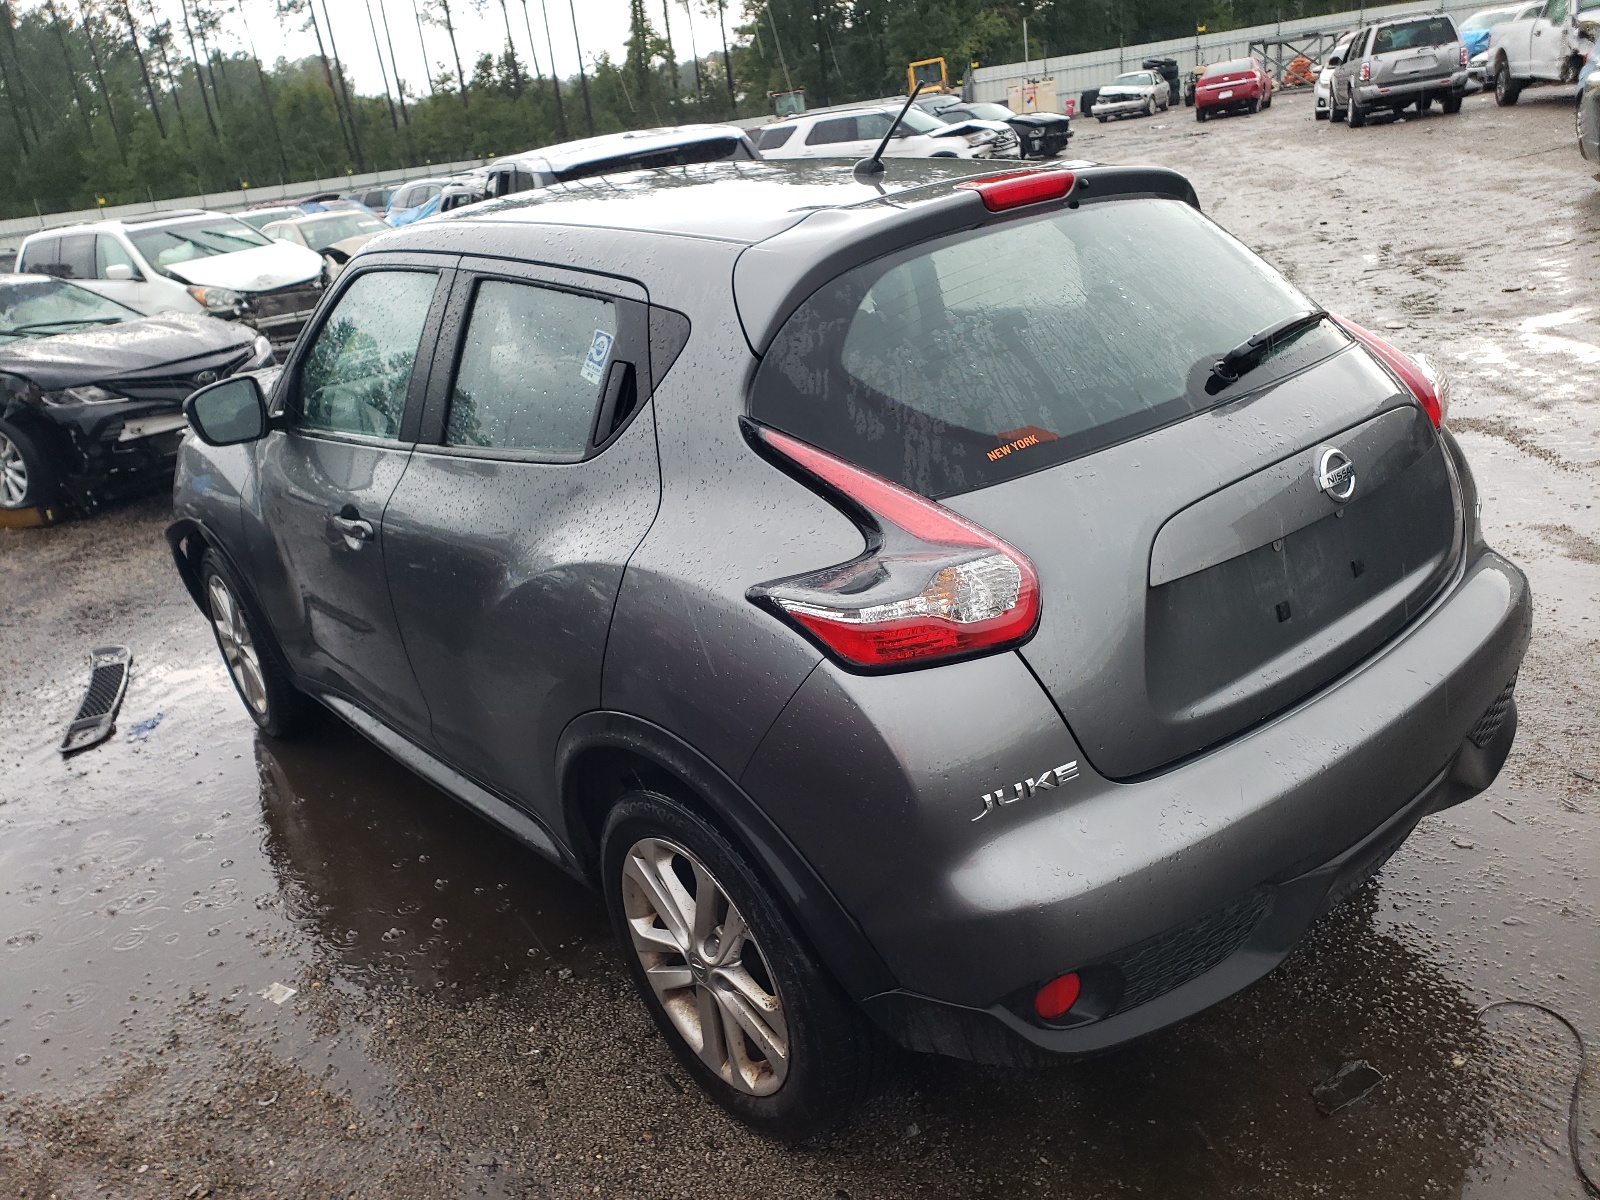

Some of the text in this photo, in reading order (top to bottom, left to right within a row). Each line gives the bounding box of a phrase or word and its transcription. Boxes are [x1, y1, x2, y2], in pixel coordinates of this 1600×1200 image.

[986, 434, 1040, 462] NEW YORK
[970, 760, 1080, 822] JUKE
